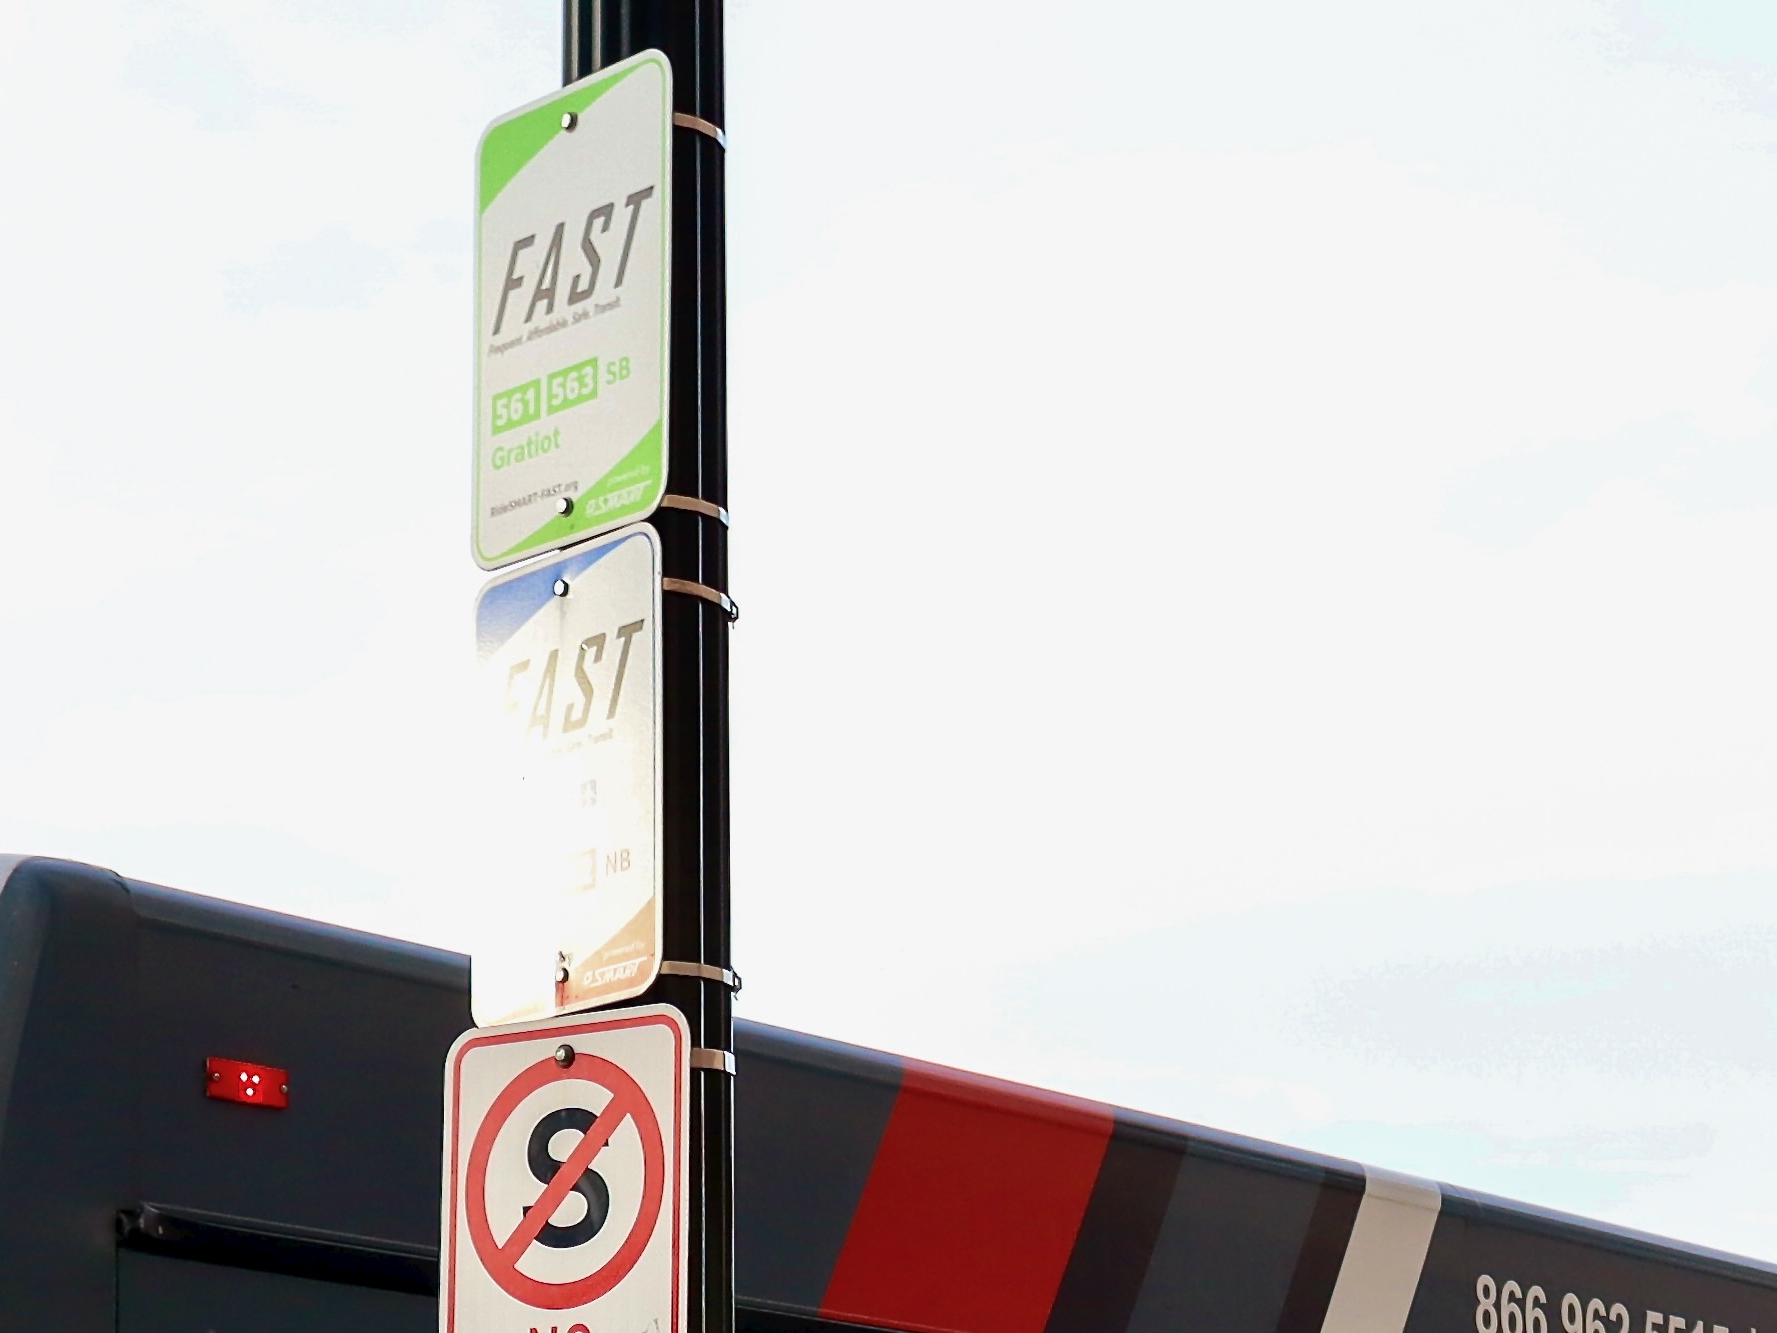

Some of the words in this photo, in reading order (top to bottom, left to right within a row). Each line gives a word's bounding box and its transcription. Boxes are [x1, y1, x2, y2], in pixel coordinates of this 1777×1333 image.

[492, 184, 655, 337] FAST
[495, 388, 536, 427] 561
[551, 366, 594, 406] 563
[606, 356, 631, 385] SB
[491, 426, 561, 471] Gratiot
[503, 618, 646, 741] FAST
[606, 847, 631, 876] NB
